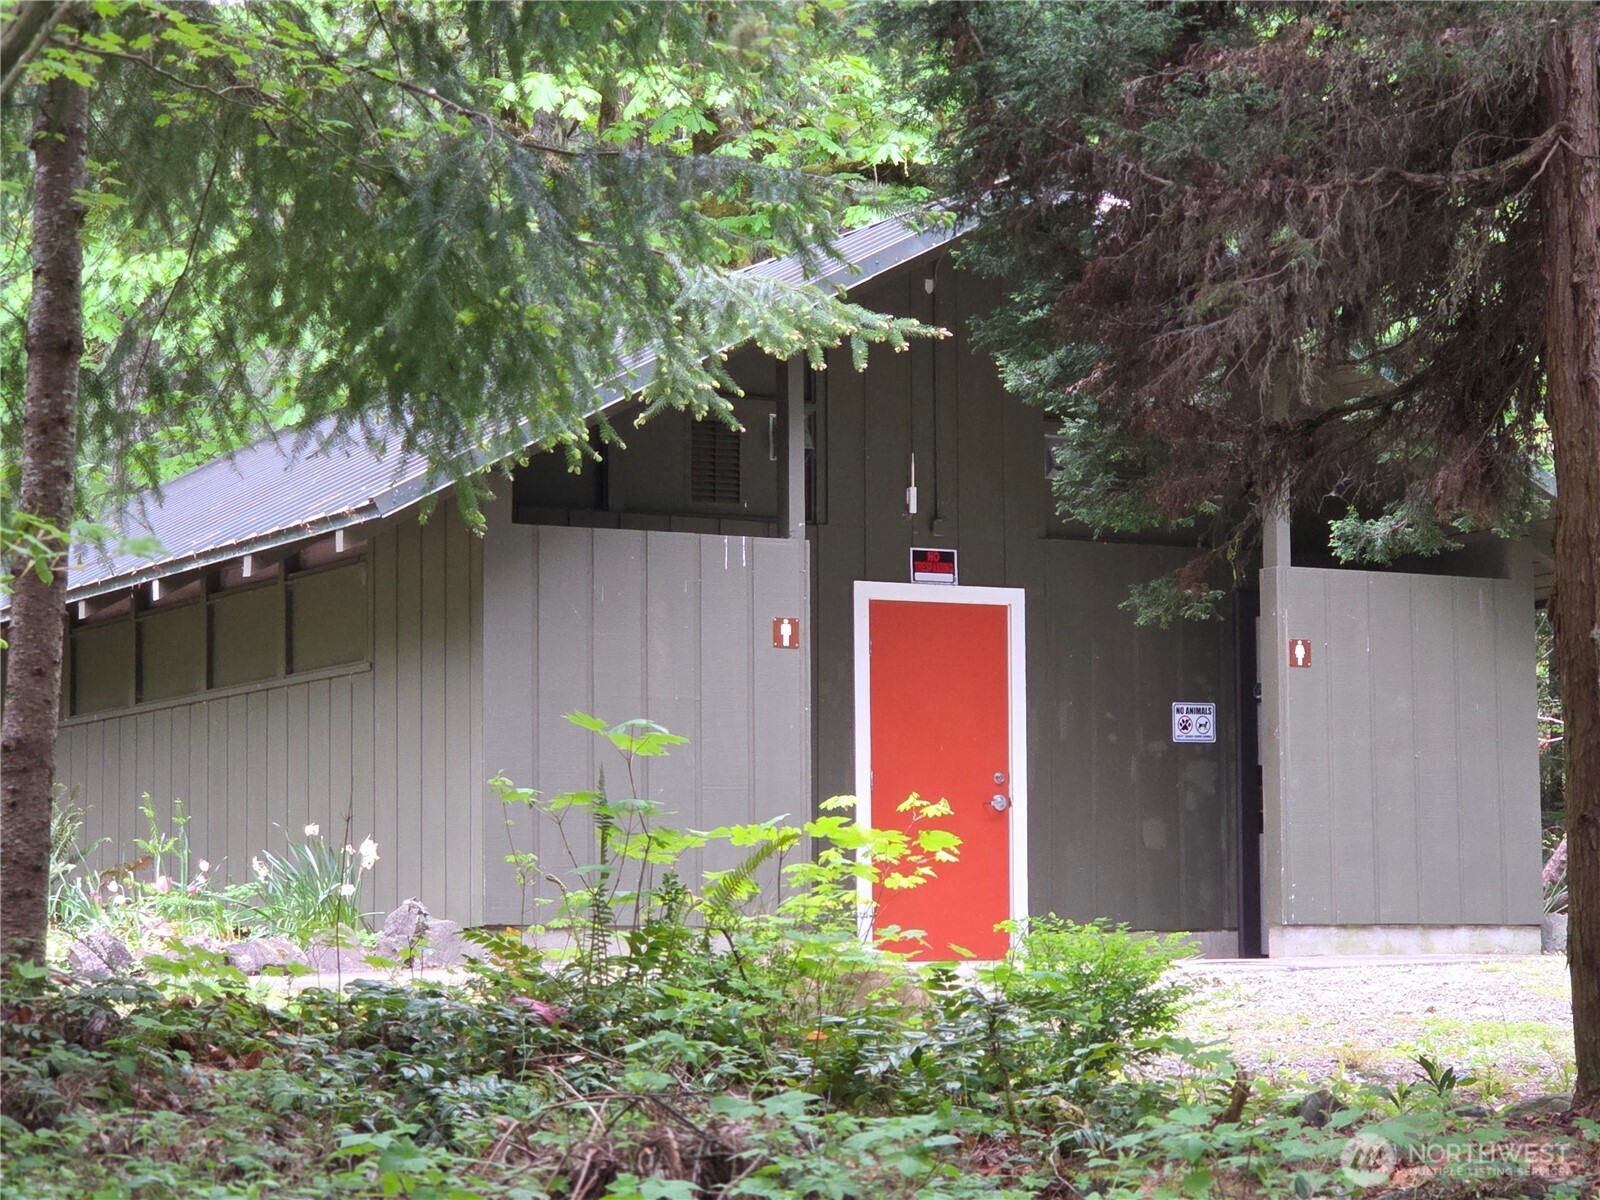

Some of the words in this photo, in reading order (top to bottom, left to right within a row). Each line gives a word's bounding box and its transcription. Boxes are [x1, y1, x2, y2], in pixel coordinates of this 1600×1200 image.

[928, 552, 940, 561] NO
[1176, 707, 1184, 715] NO
[1185, 707, 1212, 715] ANIMALS
